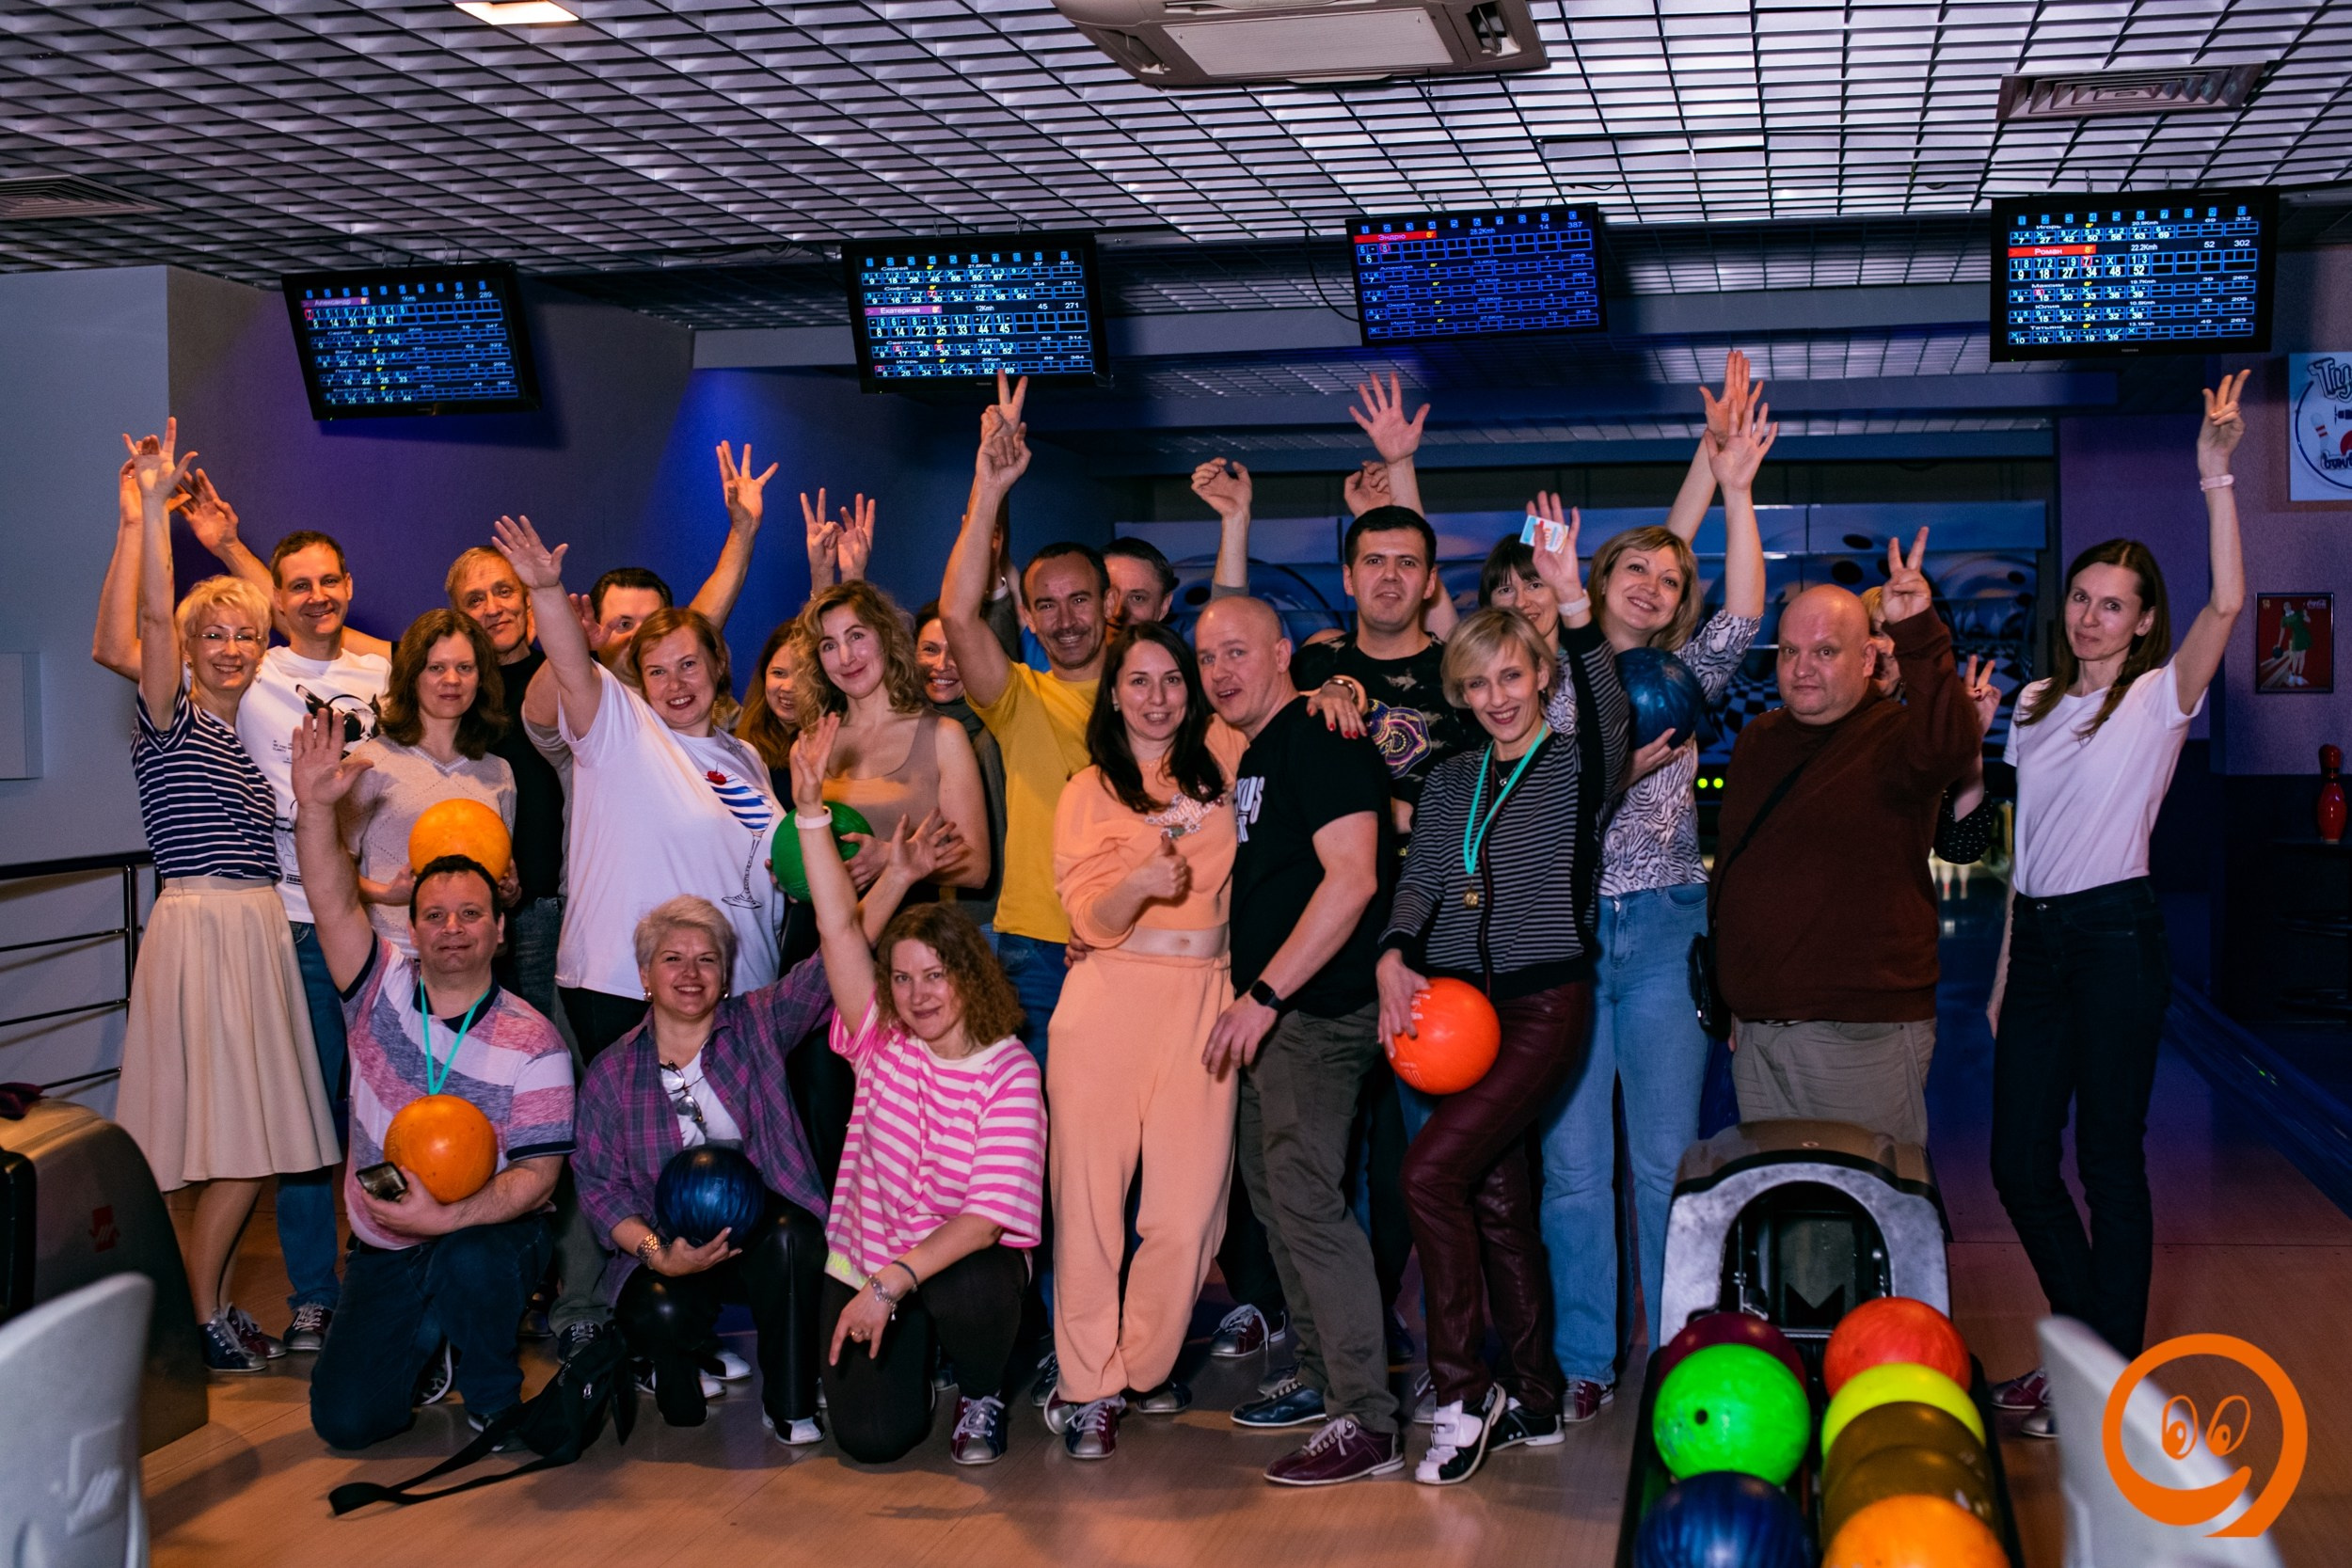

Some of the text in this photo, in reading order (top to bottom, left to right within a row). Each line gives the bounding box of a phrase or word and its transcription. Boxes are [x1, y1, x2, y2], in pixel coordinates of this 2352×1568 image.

[1366, 255, 1372, 263] 6
[2018, 266, 2144, 280] 9 18 27 34 48 52
[313, 316, 394, 328] 8 14 31 40 47
[877, 325, 1009, 337] 8 14 22 25 33 44 45
